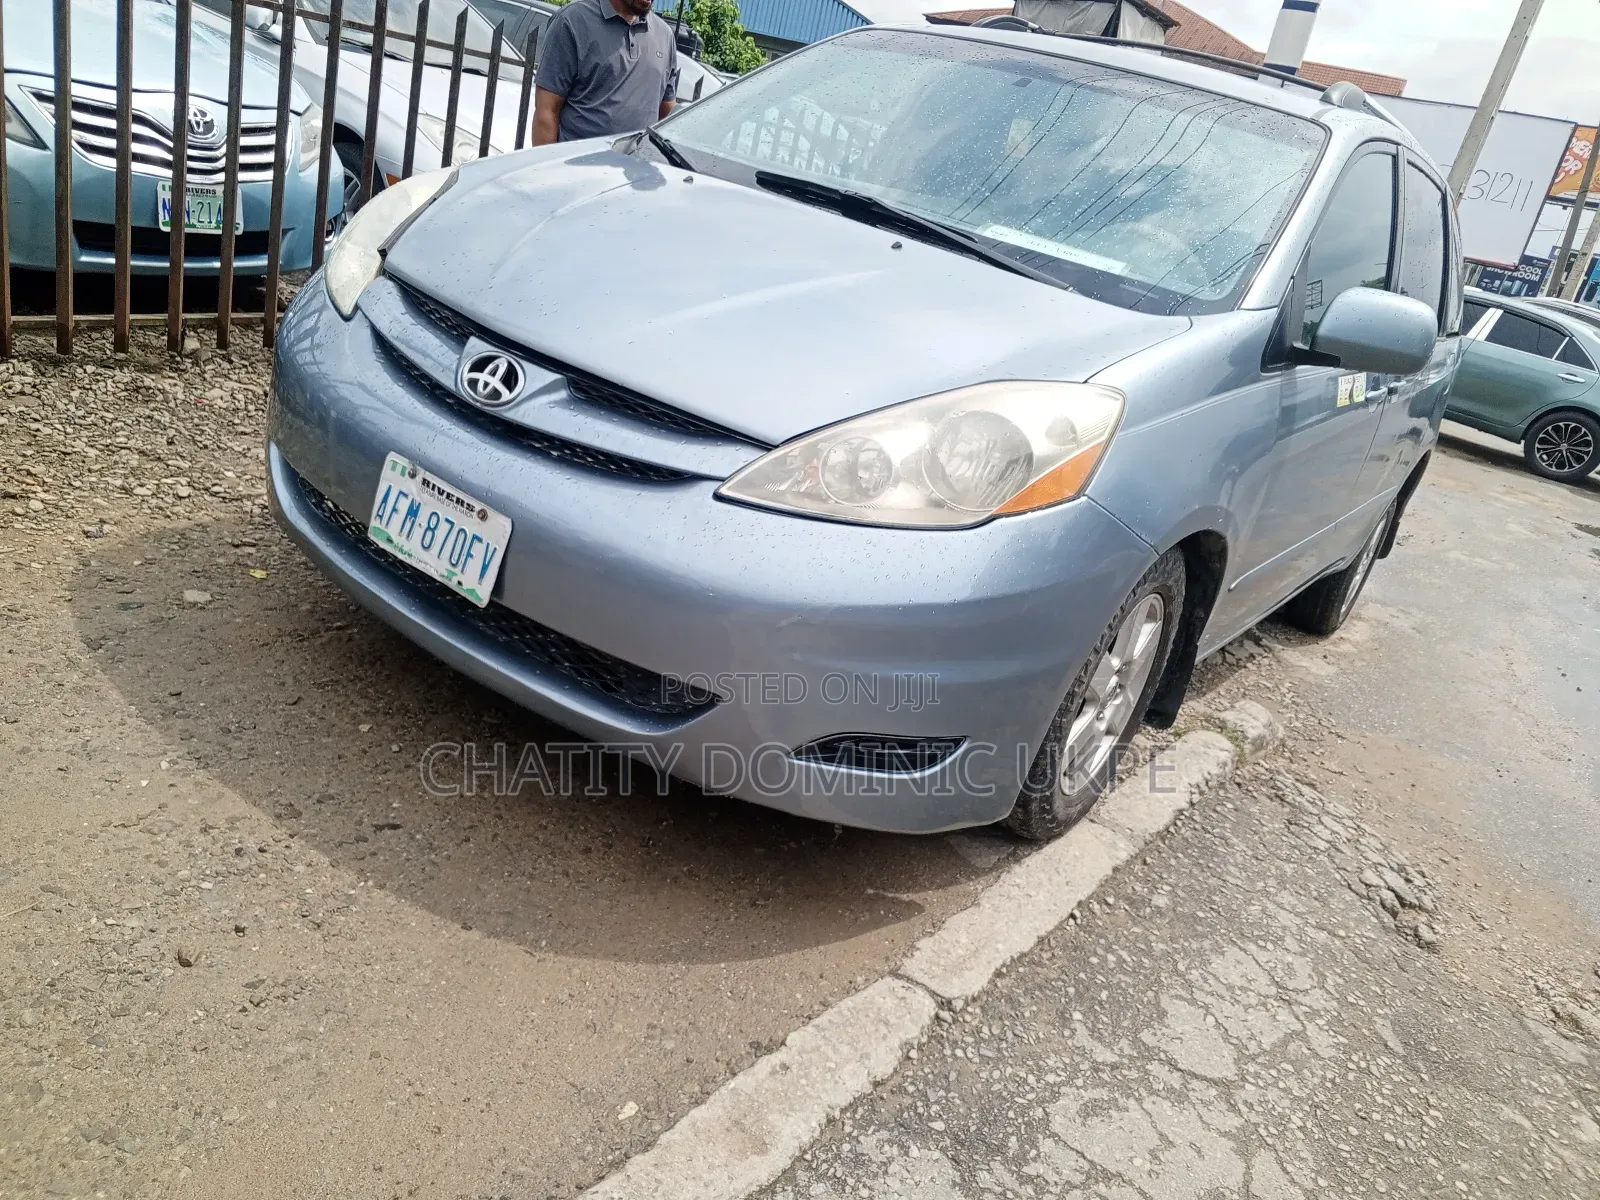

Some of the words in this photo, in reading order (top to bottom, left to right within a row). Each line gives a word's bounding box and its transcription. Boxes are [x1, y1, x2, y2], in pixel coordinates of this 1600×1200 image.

[186, 187, 217, 195] RIVERS
[1461, 169, 1534, 212] 31211
[1518, 264, 1543, 275] COOL
[421, 477, 476, 513] RIVERS
